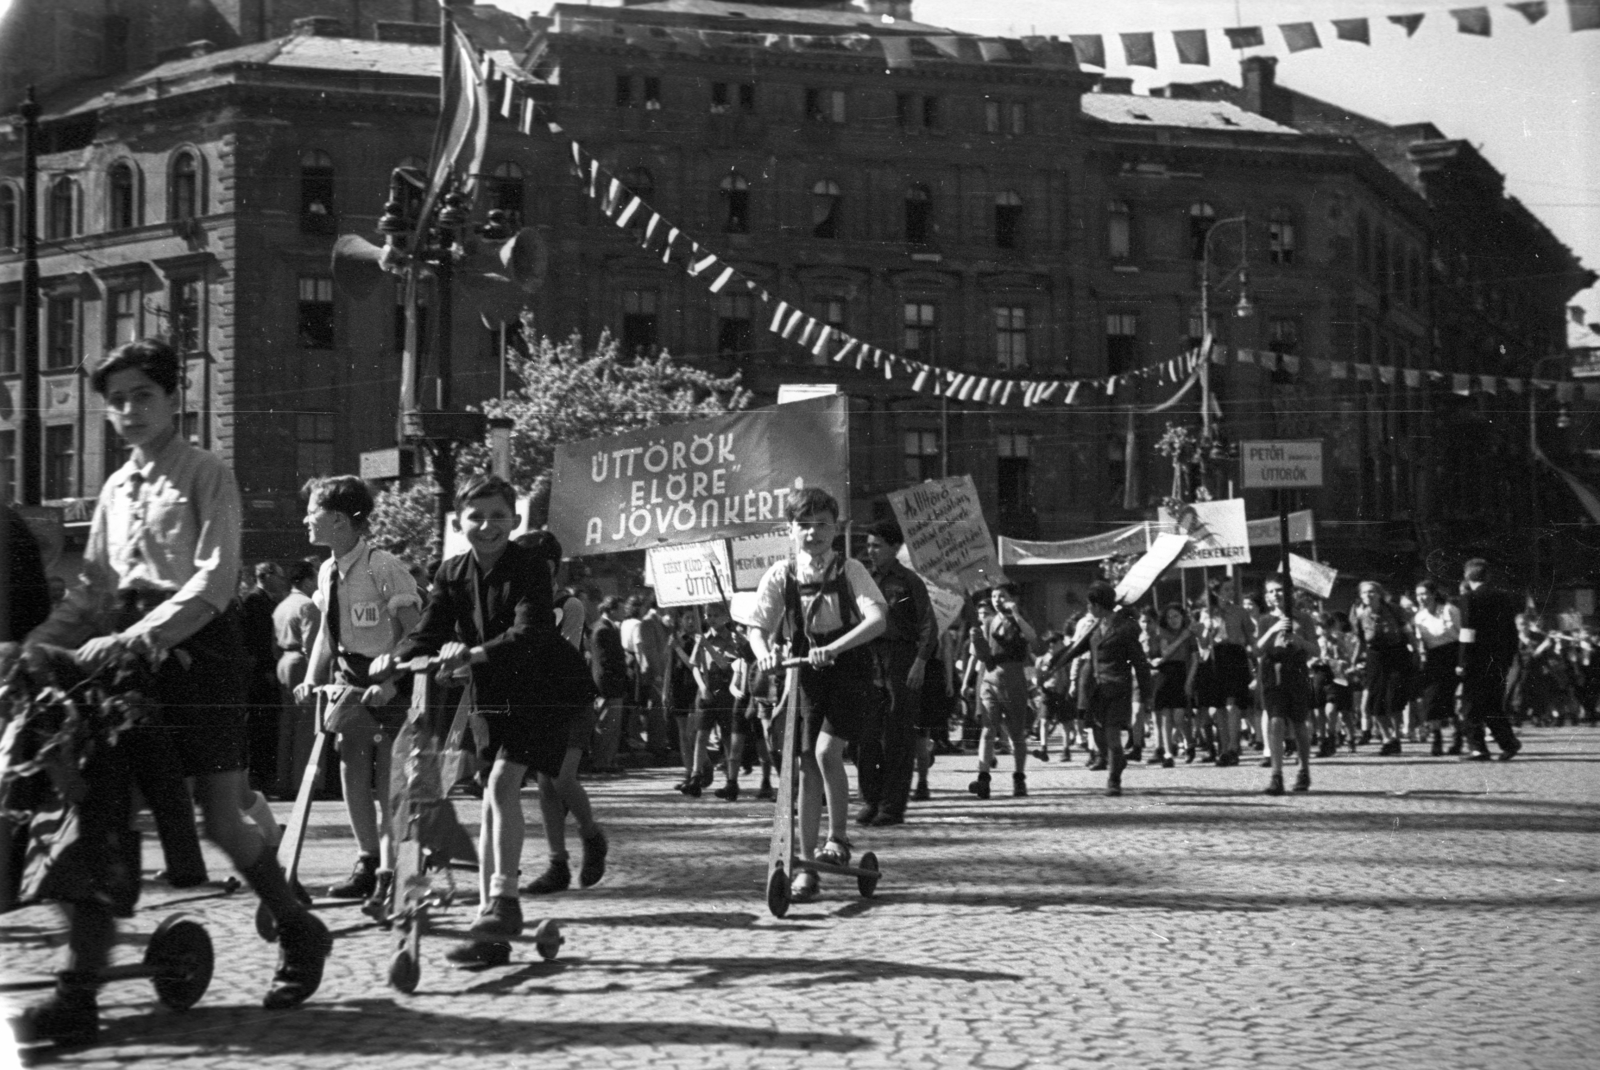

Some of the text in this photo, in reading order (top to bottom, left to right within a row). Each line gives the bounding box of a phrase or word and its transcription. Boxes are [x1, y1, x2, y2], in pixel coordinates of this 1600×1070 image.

[590, 432, 736, 483] ÚTTÖRŐK
[1249, 444, 1285, 461] PETŐFI
[585, 516, 603, 547] A
